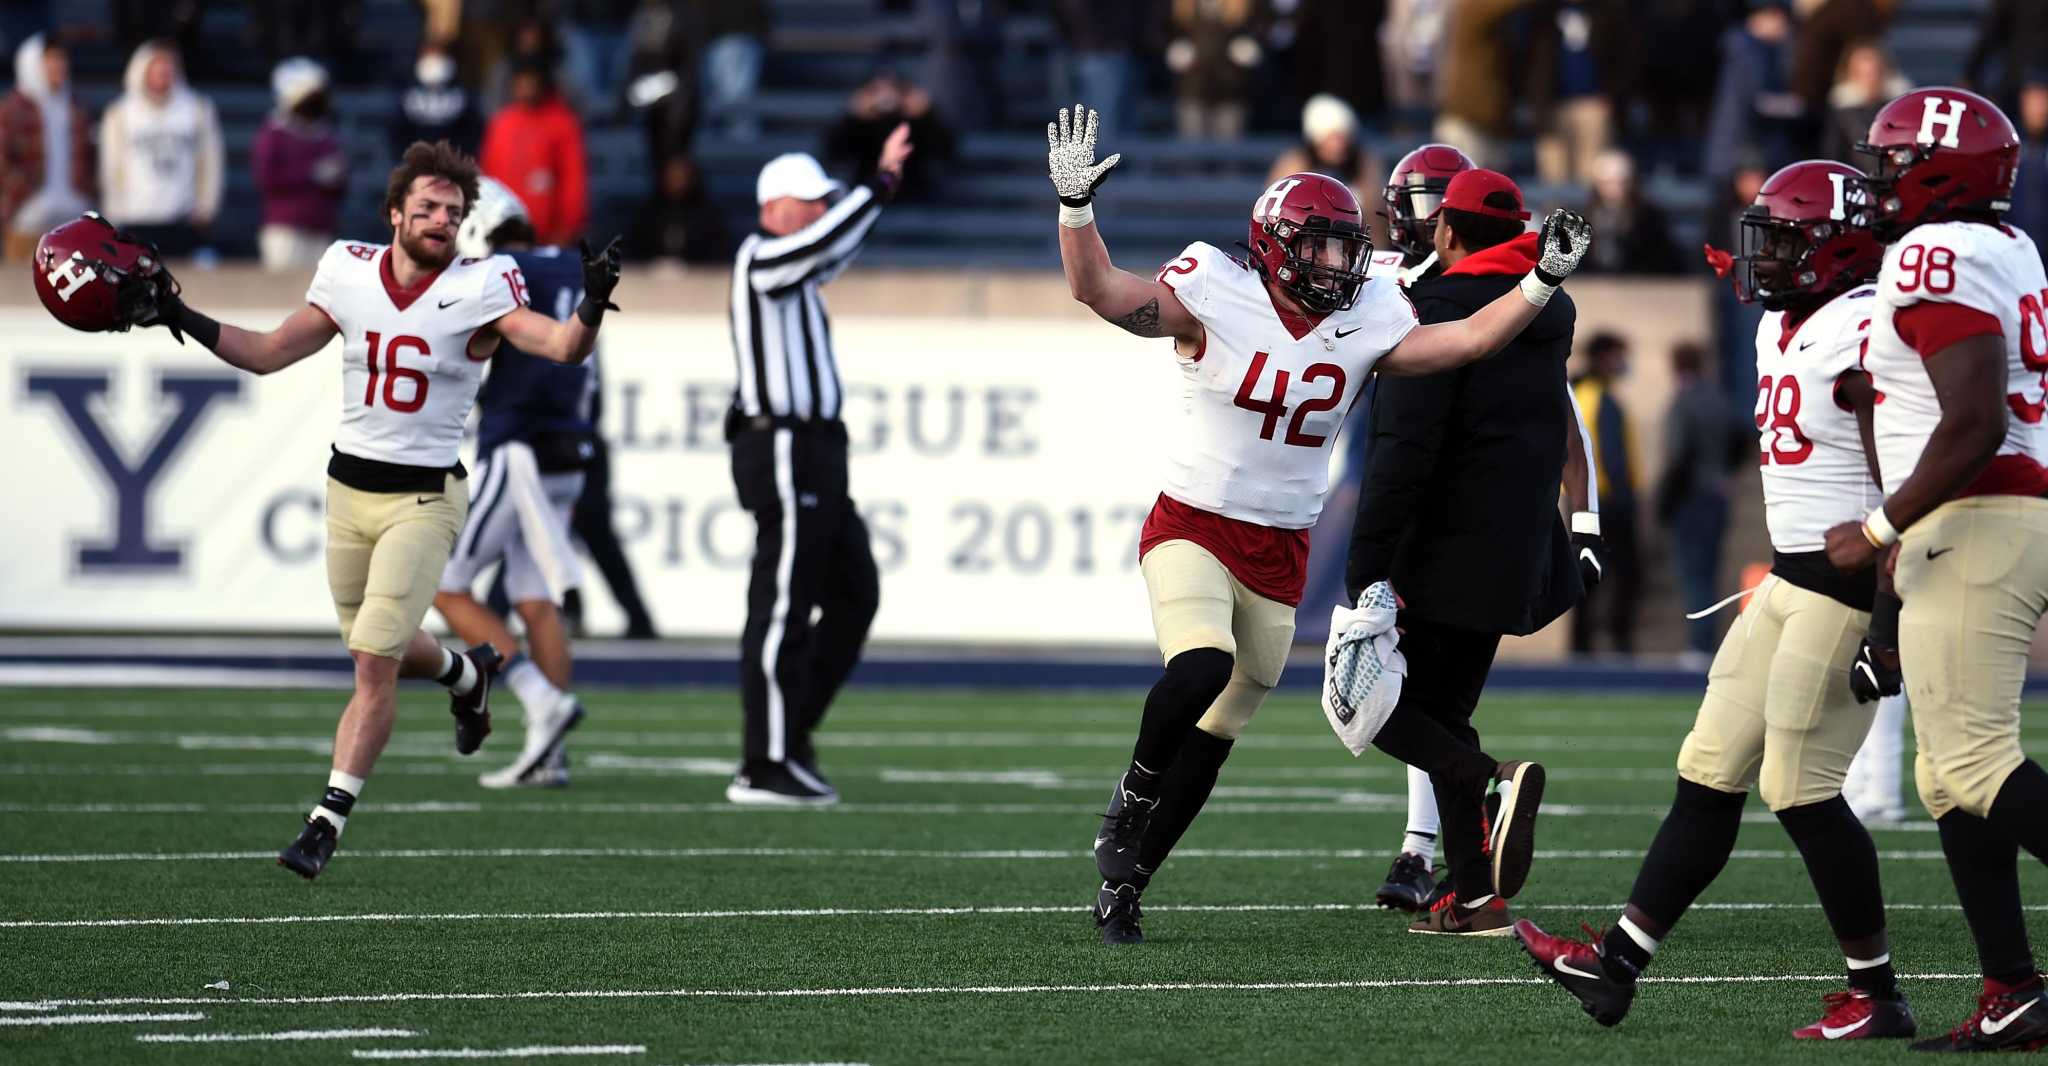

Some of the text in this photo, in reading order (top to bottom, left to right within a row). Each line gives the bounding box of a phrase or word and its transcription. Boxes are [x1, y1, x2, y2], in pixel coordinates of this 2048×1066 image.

[1916, 96, 1967, 149] H
[1253, 179, 1302, 217] H
[47, 250, 97, 302] H
[1896, 244, 1956, 294] 98
[364, 331, 432, 414] 16
[1233, 351, 1347, 447] 42
[616, 380, 1041, 456] LEGUE
[1754, 374, 1814, 465] 28
[21, 367, 246, 572] Y
[948, 500, 1152, 576] 2017
